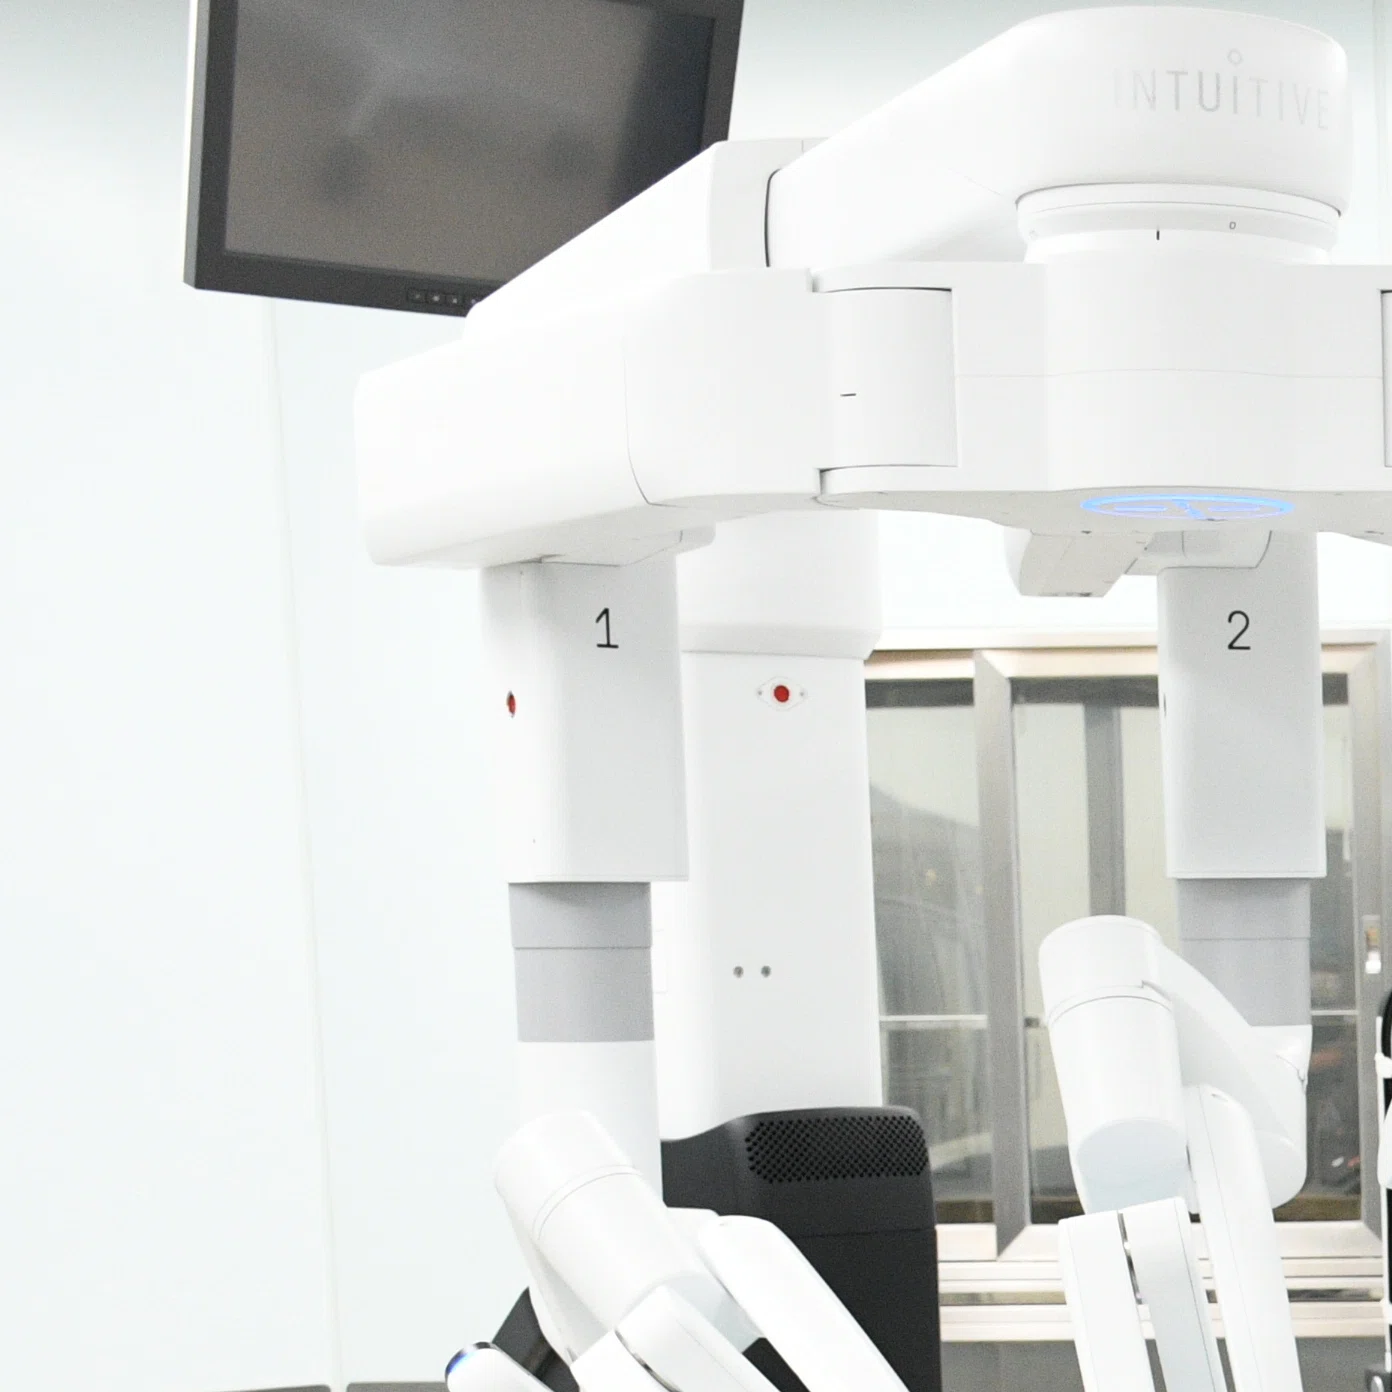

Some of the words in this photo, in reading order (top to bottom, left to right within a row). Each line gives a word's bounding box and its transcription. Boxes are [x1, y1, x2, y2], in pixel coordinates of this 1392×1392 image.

[1112, 48, 1329, 130] INTUITIVE
[596, 608, 619, 649] 1
[1228, 610, 1251, 650] 2
